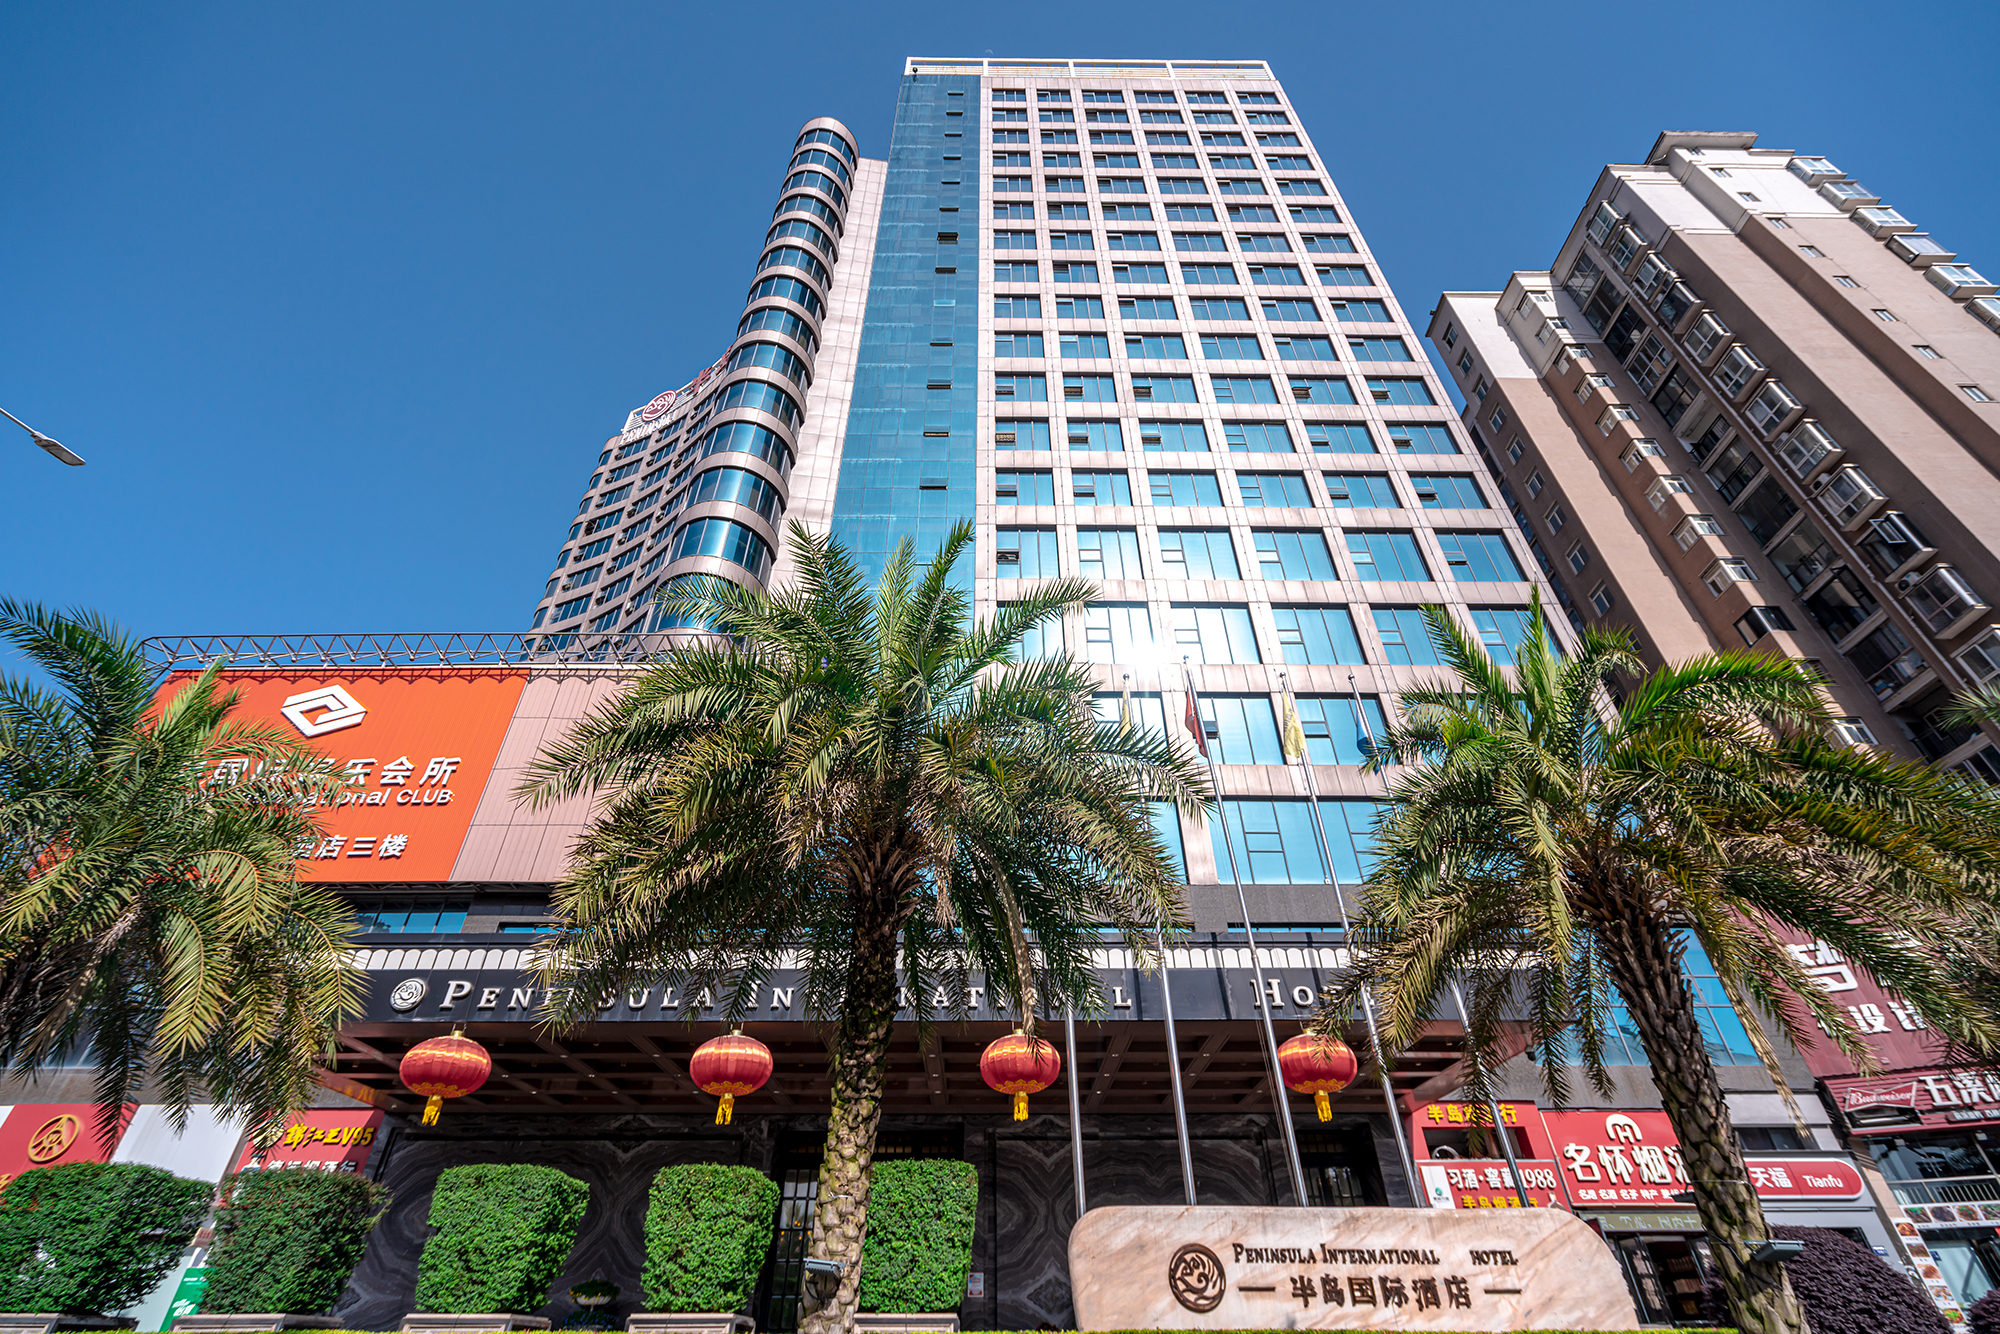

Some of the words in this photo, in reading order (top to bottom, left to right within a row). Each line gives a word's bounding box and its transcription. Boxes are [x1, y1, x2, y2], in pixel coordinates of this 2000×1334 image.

[396, 788, 452, 805] CLUB
[1748, 1167, 1793, 1188] 天福
[1802, 1174, 1844, 1188] Tianfu
[1232, 1243, 1317, 1264] PENINSULA
[1320, 1243, 1440, 1265] INTERNATIONAL
[1469, 1250, 1519, 1265] HOTEL
[1290, 1274, 1472, 1312] 半岛国际酒店
